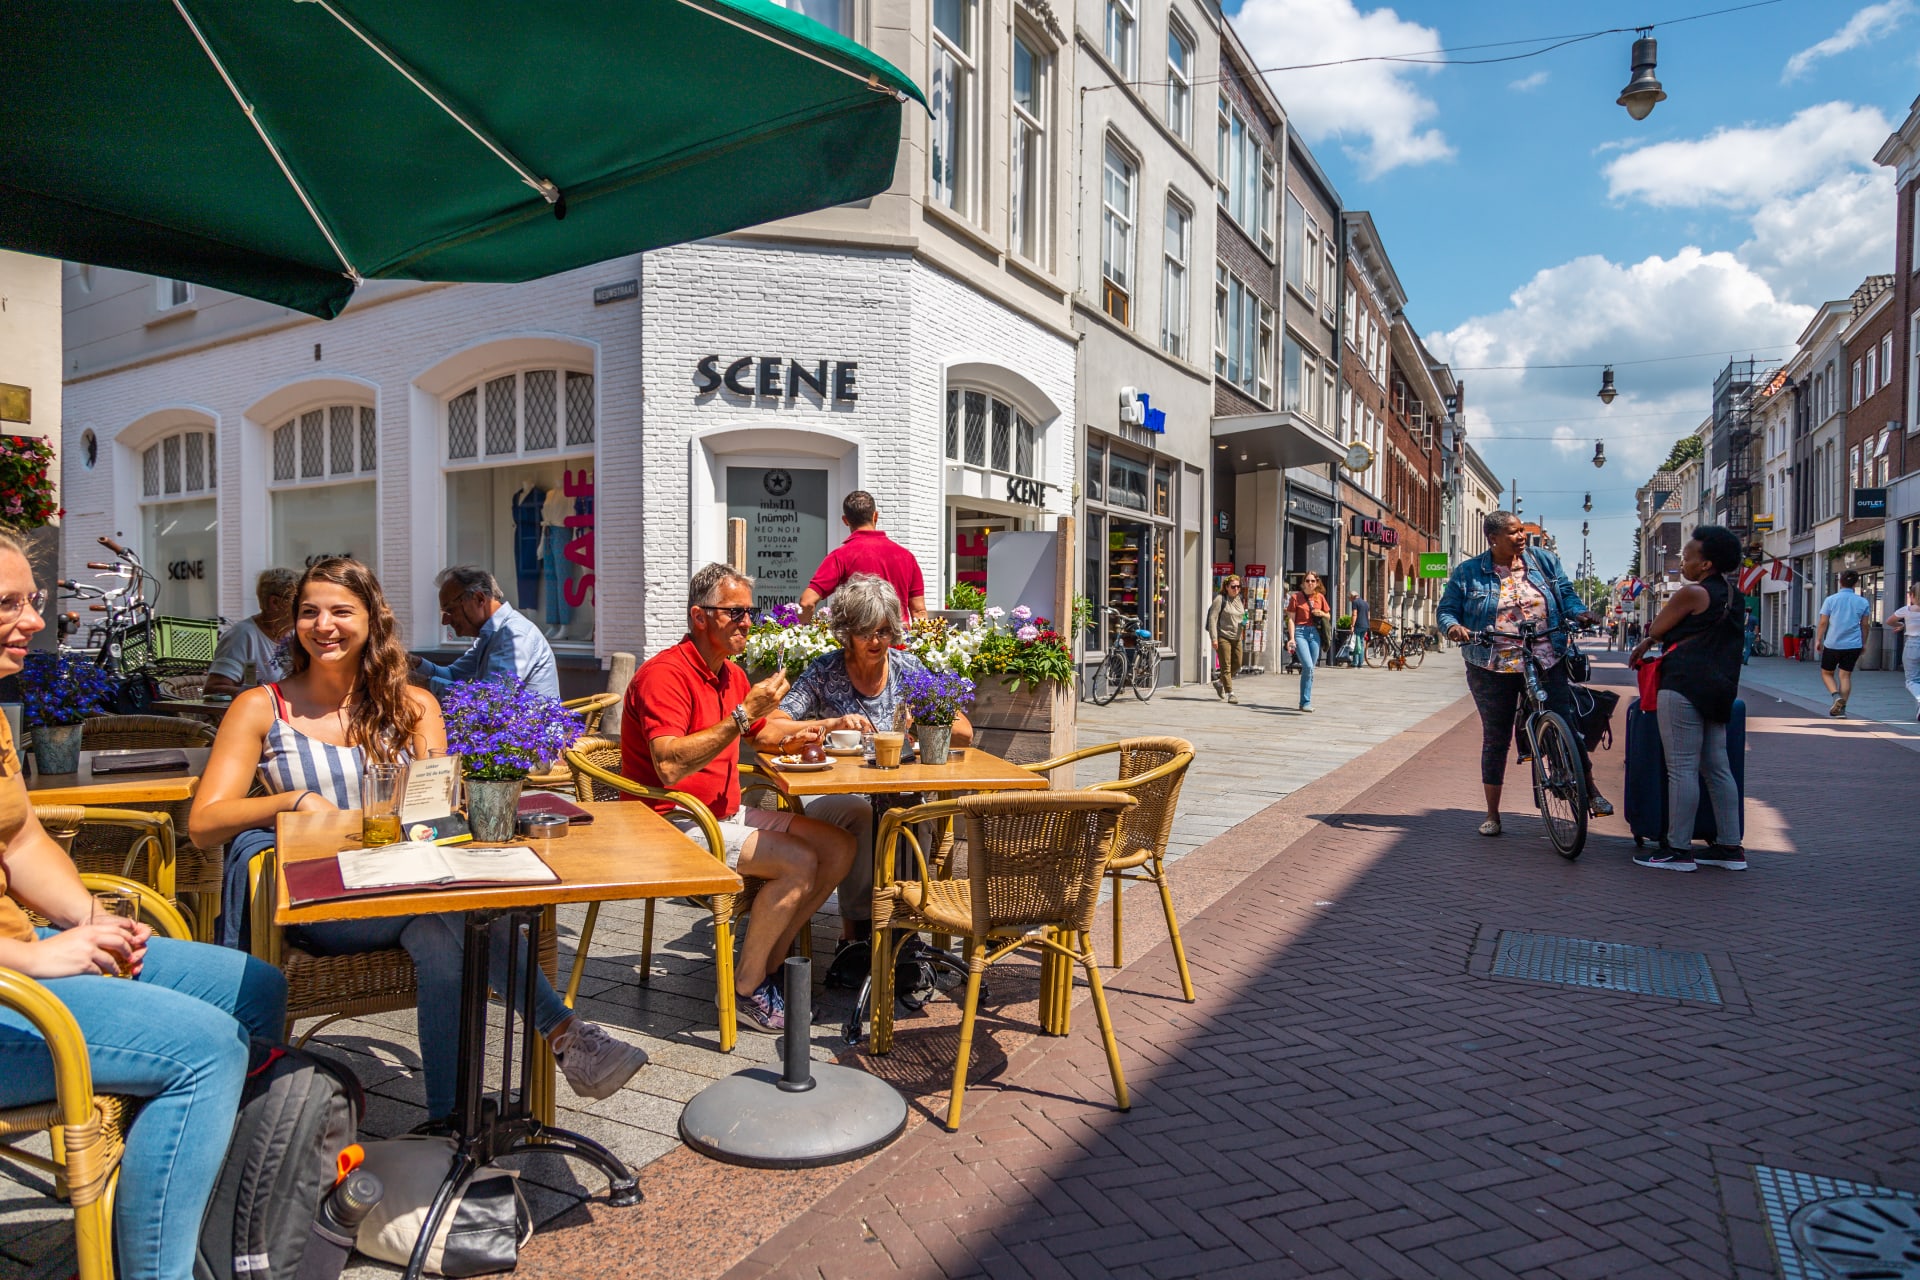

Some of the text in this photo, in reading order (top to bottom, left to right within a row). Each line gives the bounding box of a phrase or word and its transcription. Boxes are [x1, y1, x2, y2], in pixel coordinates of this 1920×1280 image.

[696, 355, 859, 401] SCENE
[1007, 475, 1046, 508] SCENE
[564, 469, 595, 608] SALE
[168, 560, 205, 580] SCENE
[1426, 563, 1447, 571] casa
